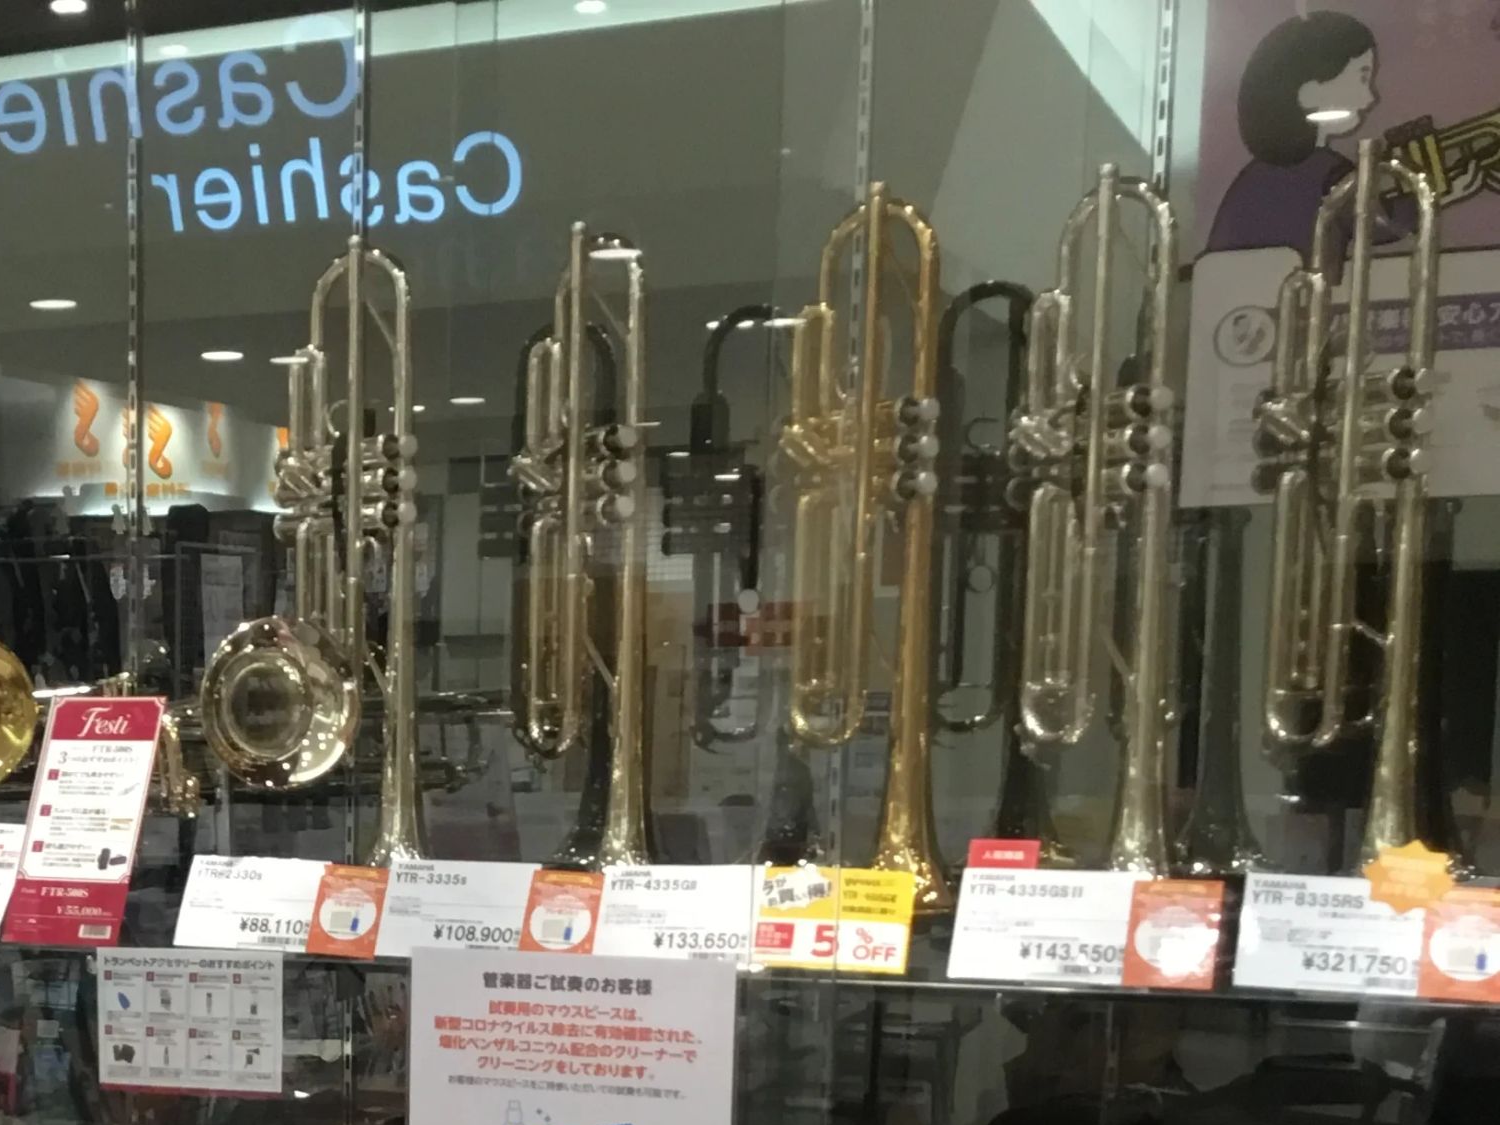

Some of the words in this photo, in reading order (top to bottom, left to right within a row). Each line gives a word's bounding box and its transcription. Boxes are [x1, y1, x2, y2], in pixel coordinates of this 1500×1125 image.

[78, 707, 131, 737] Festi
[1251, 890, 1365, 909] YTR-8335RS
[240, 916, 304, 935] ¥88,110
[433, 924, 514, 943] ¥108,900
[653, 932, 740, 950] ¥133,650
[810, 924, 840, 957] 5
[852, 944, 897, 962] OFF
[1302, 951, 1408, 976] ¥321,750
[482, 971, 653, 996] 管楽器ご試奏のお客様
